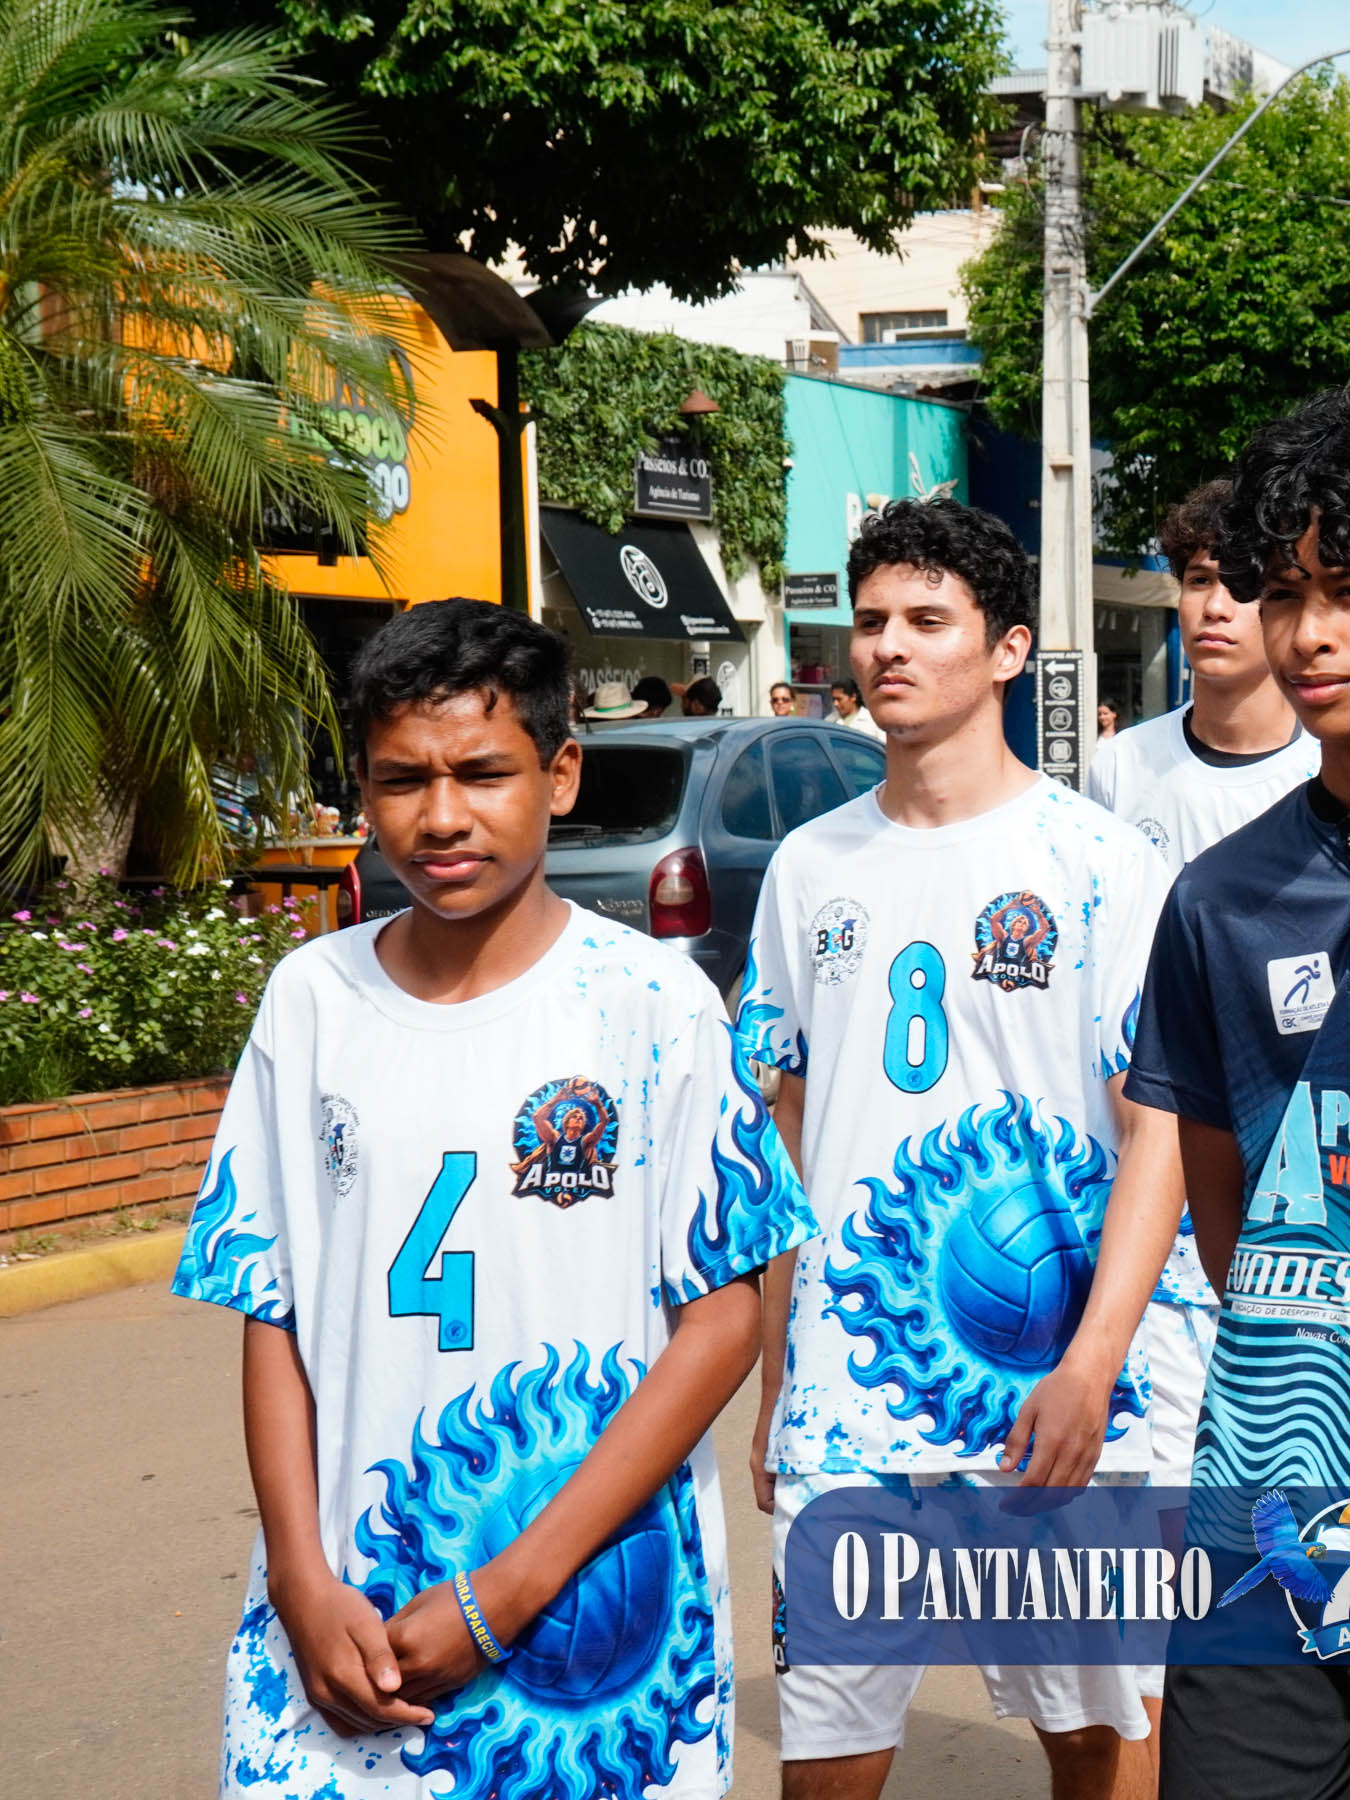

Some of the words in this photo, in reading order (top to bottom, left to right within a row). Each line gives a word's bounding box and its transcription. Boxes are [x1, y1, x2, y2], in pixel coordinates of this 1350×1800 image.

[976, 954, 1046, 983] APOLO
[883, 941, 949, 1094] 8
[518, 1163, 610, 1190] APOLO
[388, 1151, 477, 1352] 4
[1295, 1327, 1327, 1342] Novas
